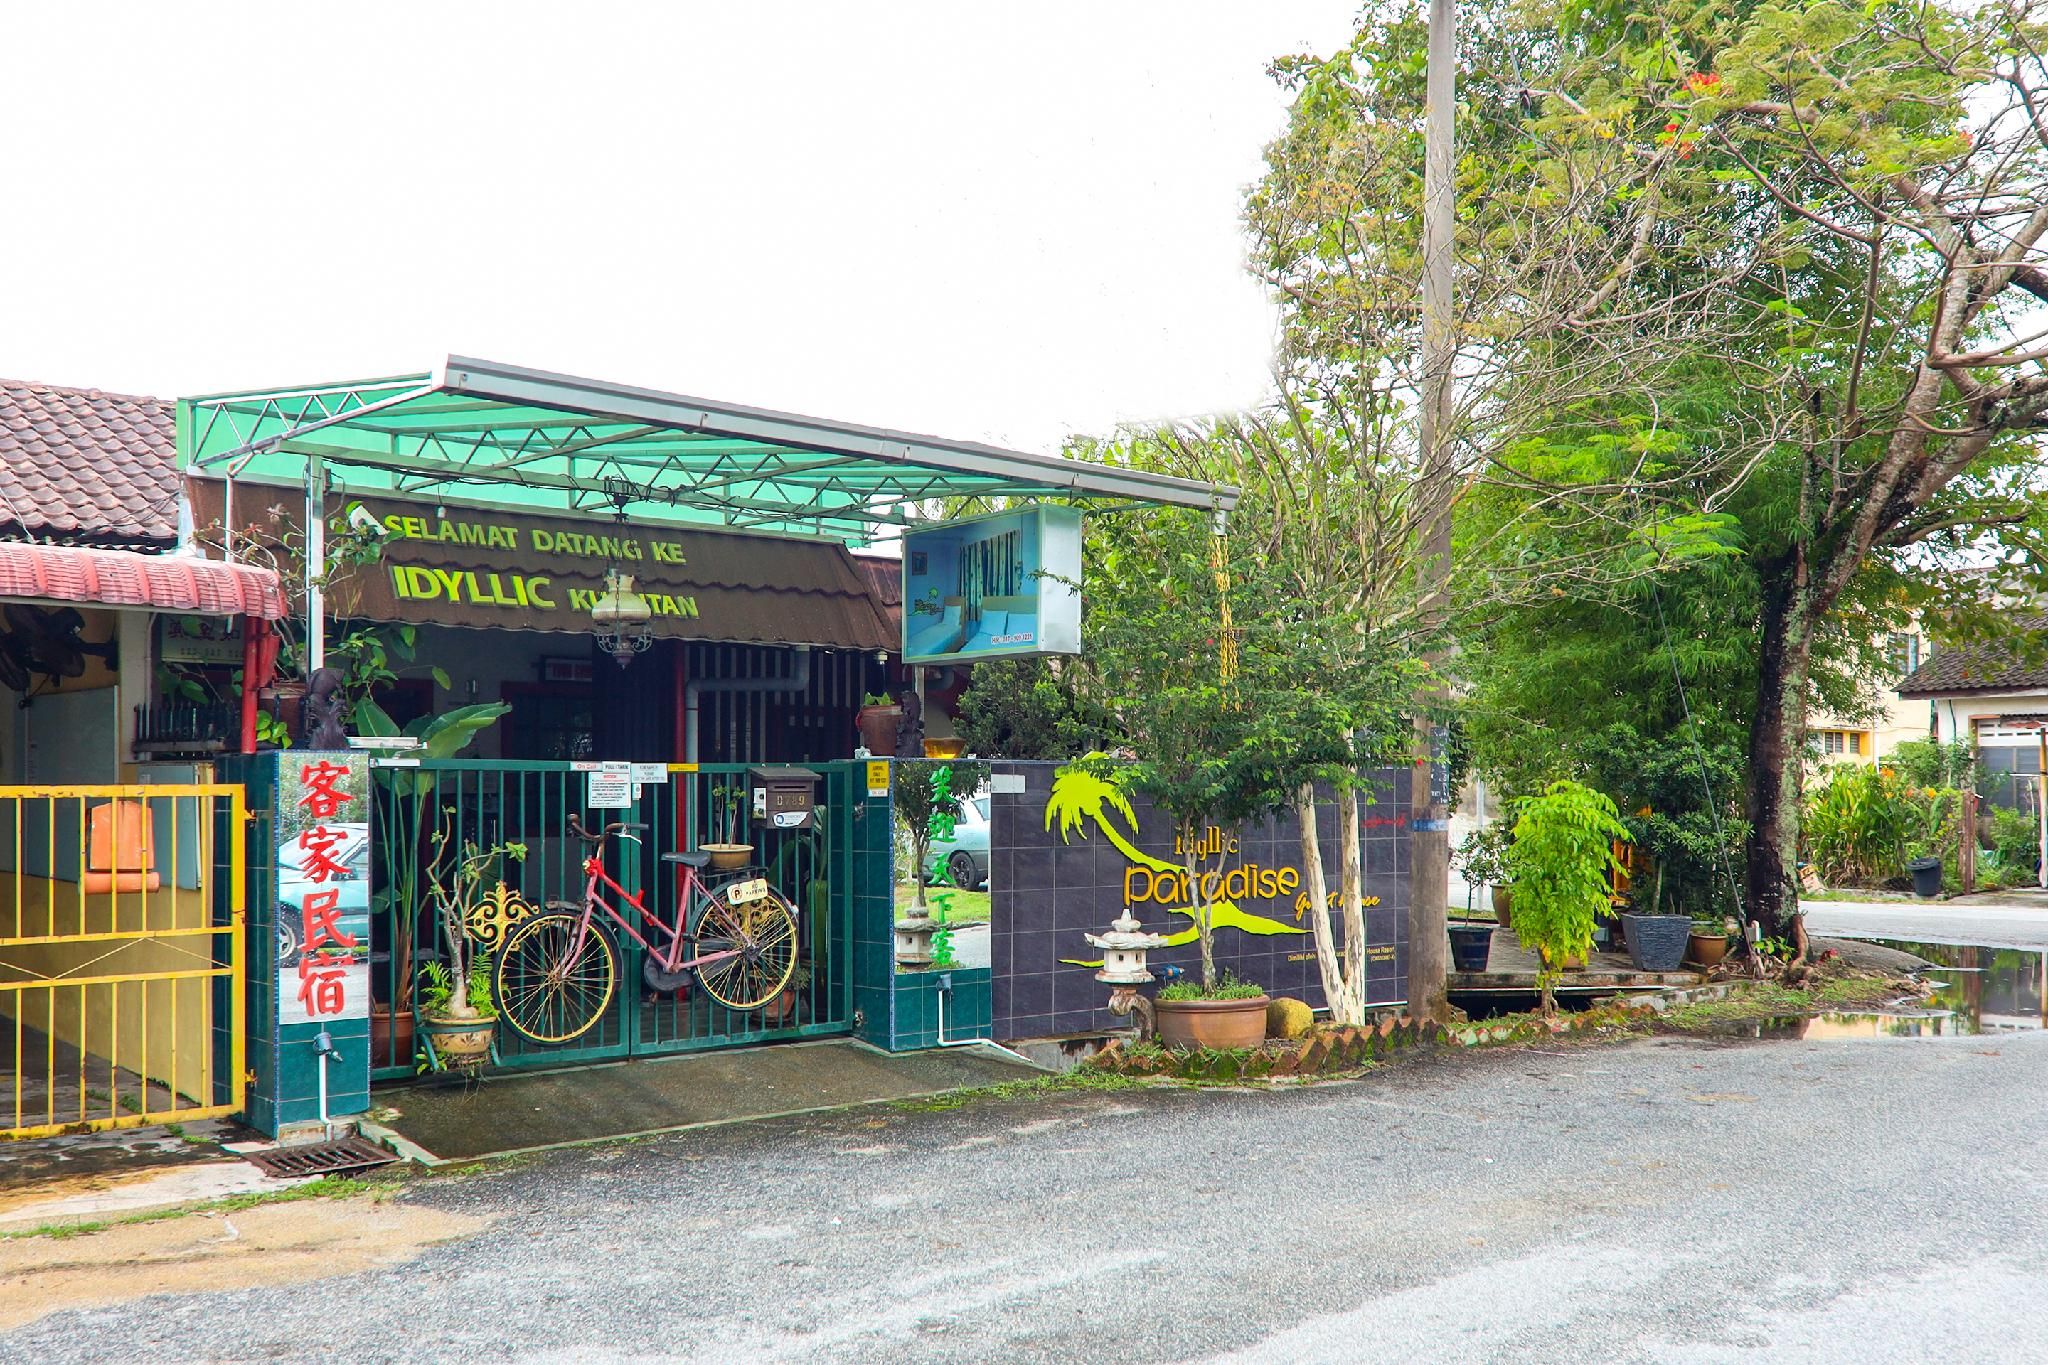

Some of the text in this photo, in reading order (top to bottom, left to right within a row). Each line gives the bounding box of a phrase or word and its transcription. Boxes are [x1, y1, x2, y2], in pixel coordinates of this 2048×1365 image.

[384, 514, 687, 565] SELAMAT DATANG KE
[391, 565, 556, 609] IDYLLIC
[297, 760, 358, 1017] 客家民宿
